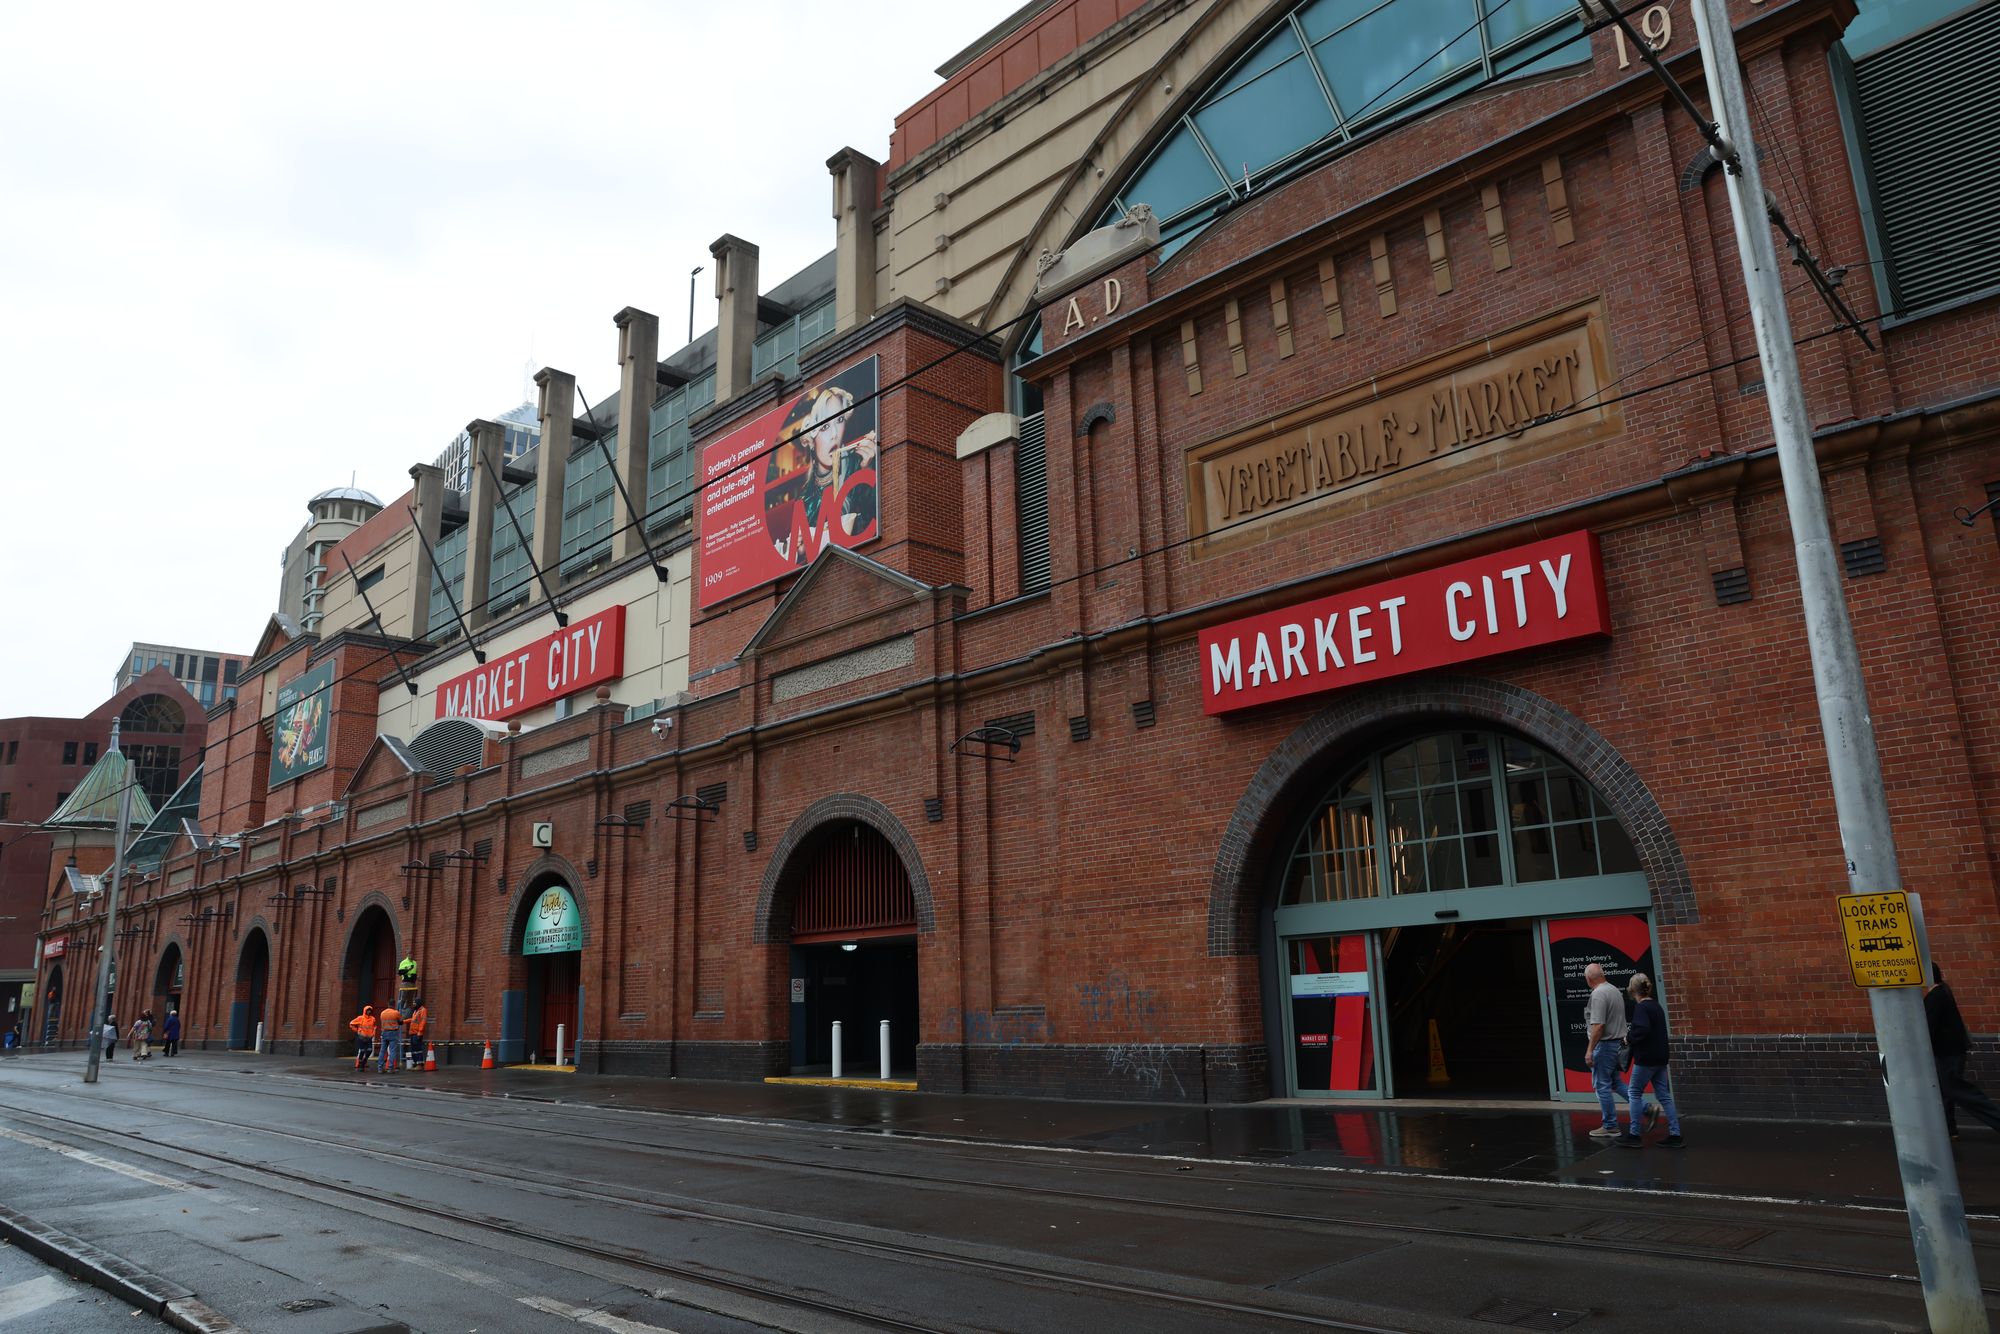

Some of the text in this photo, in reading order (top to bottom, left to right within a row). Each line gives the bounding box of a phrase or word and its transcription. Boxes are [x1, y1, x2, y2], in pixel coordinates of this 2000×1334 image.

[1216, 348, 1581, 522] VEGETABLE MARKET
[708, 438, 766, 476] Sydney's premier
[706, 470, 756, 502] and late-night
[706, 484, 755, 516] entertainment
[705, 570, 723, 587] 1909
[1209, 553, 1573, 697] MARKET CITY
[445, 621, 603, 718] MARKET CITY
[536, 824, 550, 844] C
[1843, 902, 1906, 918] LOOK FOR
[1856, 918, 1898, 931] TRAMS
[1585, 954, 1612, 962] Sydney's
[1855, 958, 1916, 969] BEFORE CROSSING
[1603, 968, 1637, 976] destination
[1881, 969, 1909, 978] TRACKS
